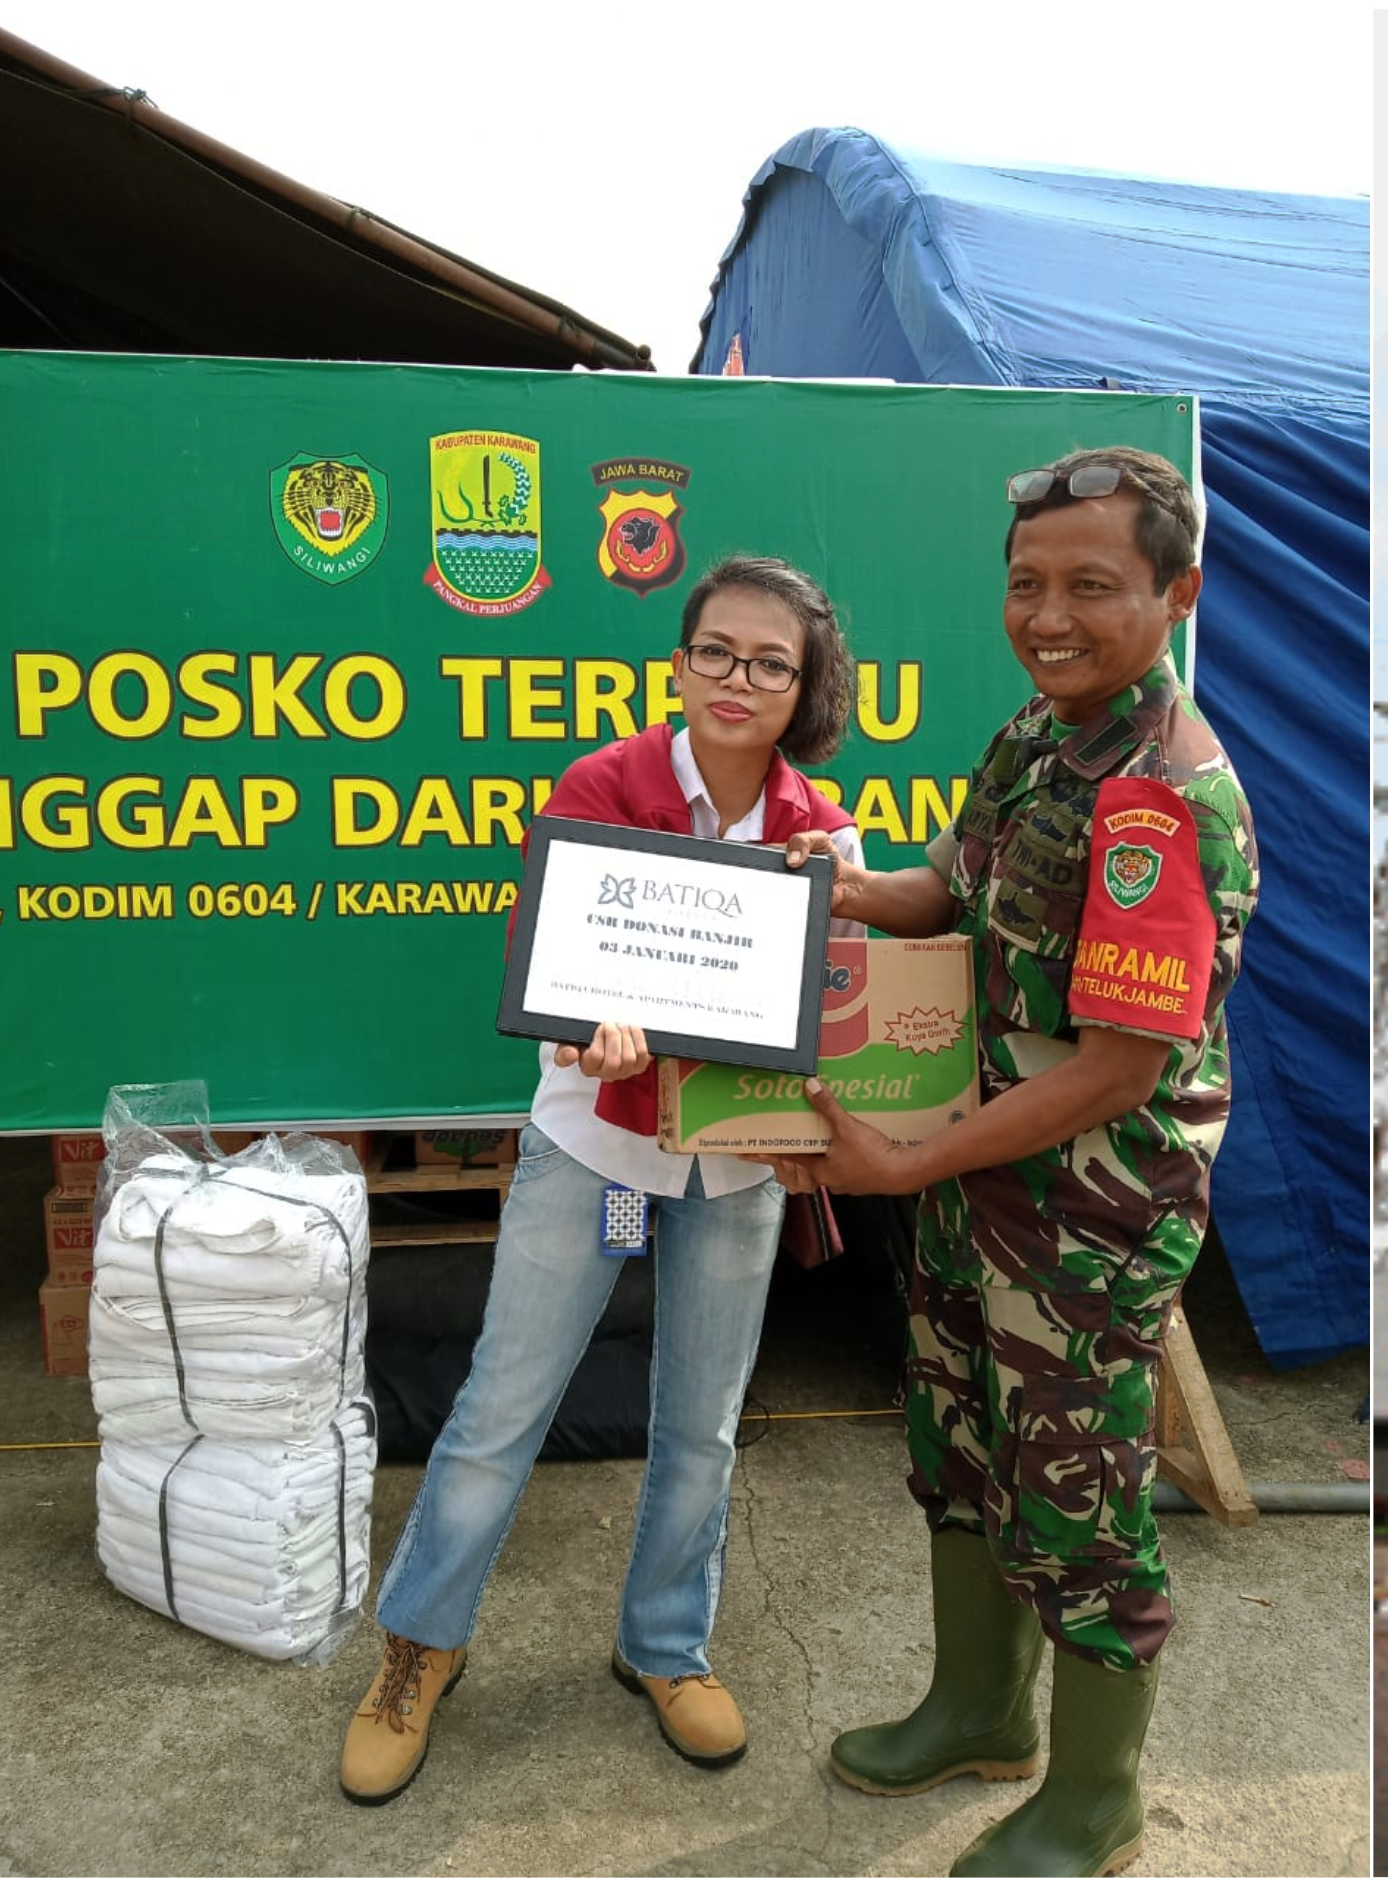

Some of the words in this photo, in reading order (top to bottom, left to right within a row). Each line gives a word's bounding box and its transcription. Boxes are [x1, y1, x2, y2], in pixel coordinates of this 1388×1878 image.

[435, 435, 486, 450] KABUPATEN
[487, 435, 536, 454] KARAWANG
[600, 464, 635, 480] JAWA
[638, 464, 684, 482] BARAT
[293, 545, 371, 574] SILIWANGI
[433, 581, 477, 614] PANGKAL
[479, 582, 542, 614] PERJUANGAN
[12, 651, 406, 740] POSKO
[440, 653, 925, 744] TERPU
[0, 775, 299, 851] GGAP
[1109, 812, 1143, 830] KODIM
[17, 884, 175, 921] KODIM
[188, 883, 297, 919] 0604
[307, 882, 324, 920] /
[336, 881, 519, 917] KARAWA
[642, 879, 743, 918] BATIQA
[624, 918, 685, 938] DONASI
[599, 941, 618, 952] 03
[623, 944, 696, 965] JANUARI
[700, 956, 739, 971] 2020
[1073, 939, 1190, 992] ANRAMIL
[733, 1074, 803, 1100] Soto
[63, 1139, 99, 1162] Vit
[748, 1138, 757, 1147] PT
[759, 1138, 800, 1147] INDOFOOD
[56, 1227, 92, 1248] Vit
